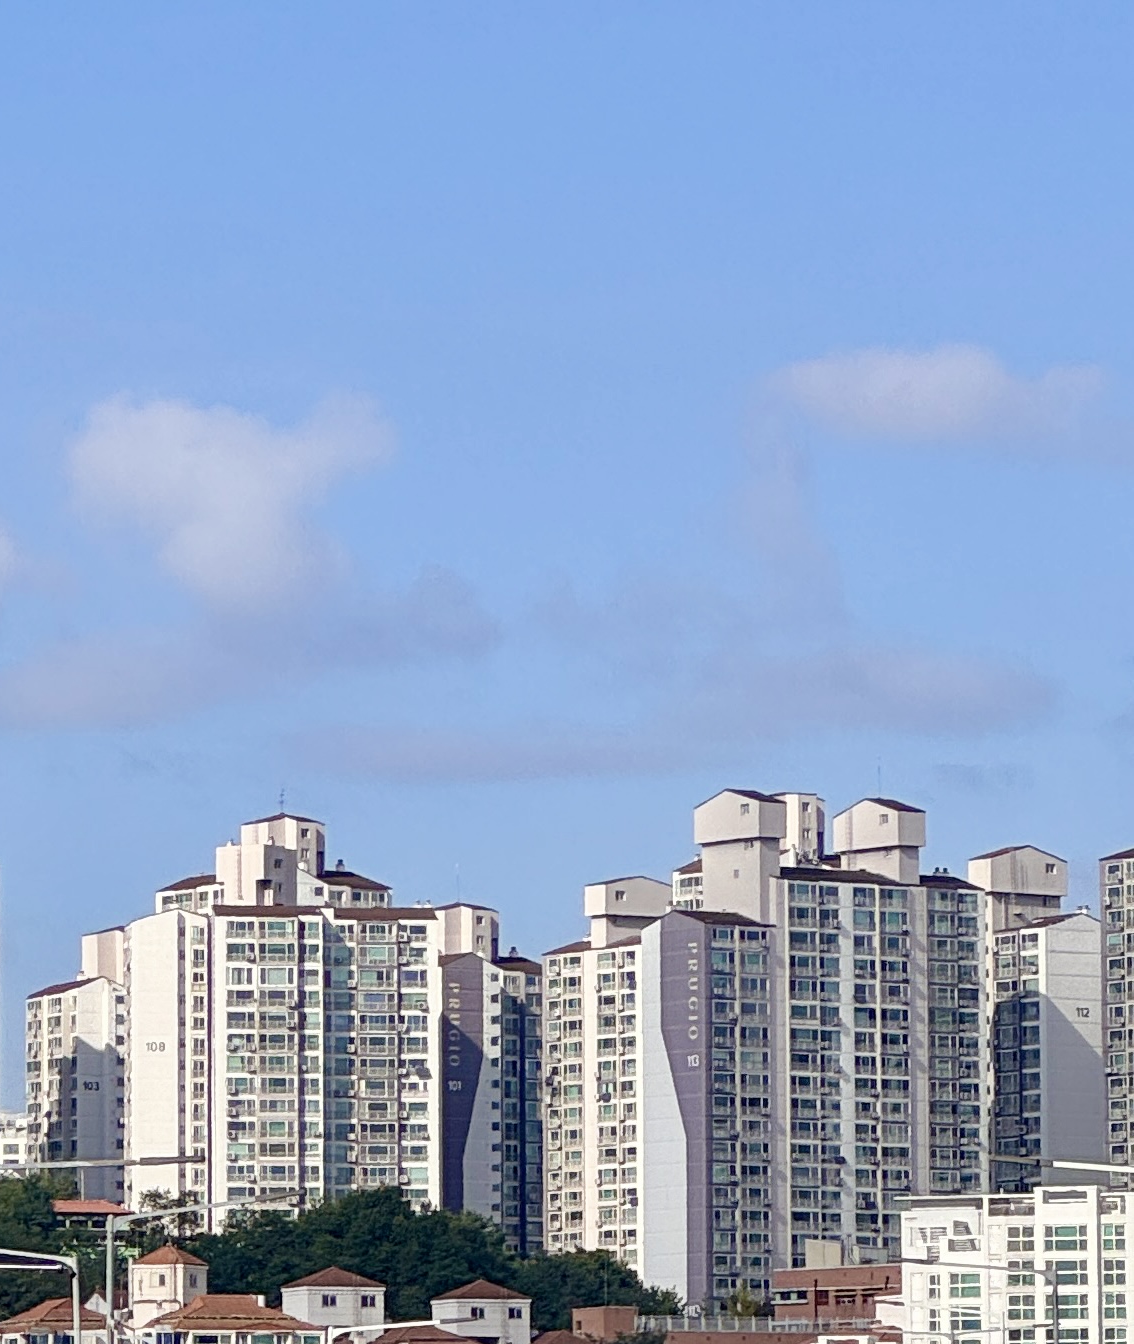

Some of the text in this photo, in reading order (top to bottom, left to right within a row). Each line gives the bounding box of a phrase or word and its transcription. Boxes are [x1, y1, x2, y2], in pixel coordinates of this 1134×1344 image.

[687, 942, 699, 1040] PRUGIO
[1076, 1007, 1090, 1017] 112
[146, 1041, 166, 1052] 108
